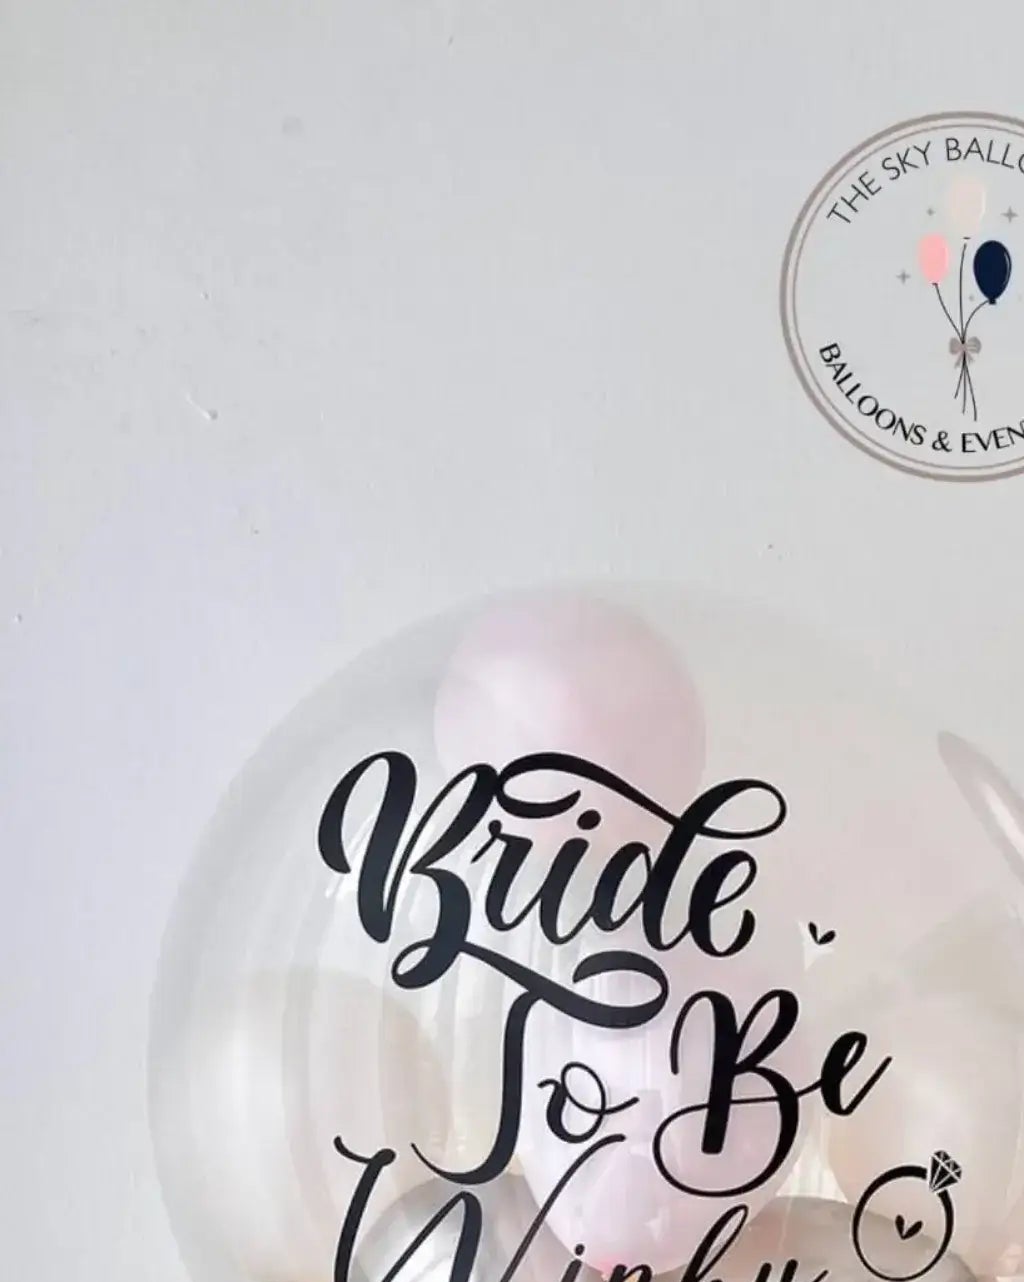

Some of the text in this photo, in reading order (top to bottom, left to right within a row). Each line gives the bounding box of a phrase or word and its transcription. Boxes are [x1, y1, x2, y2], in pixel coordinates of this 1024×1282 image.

[317, 751, 788, 989] Bride
[411, 950, 892, 1197] To Be
